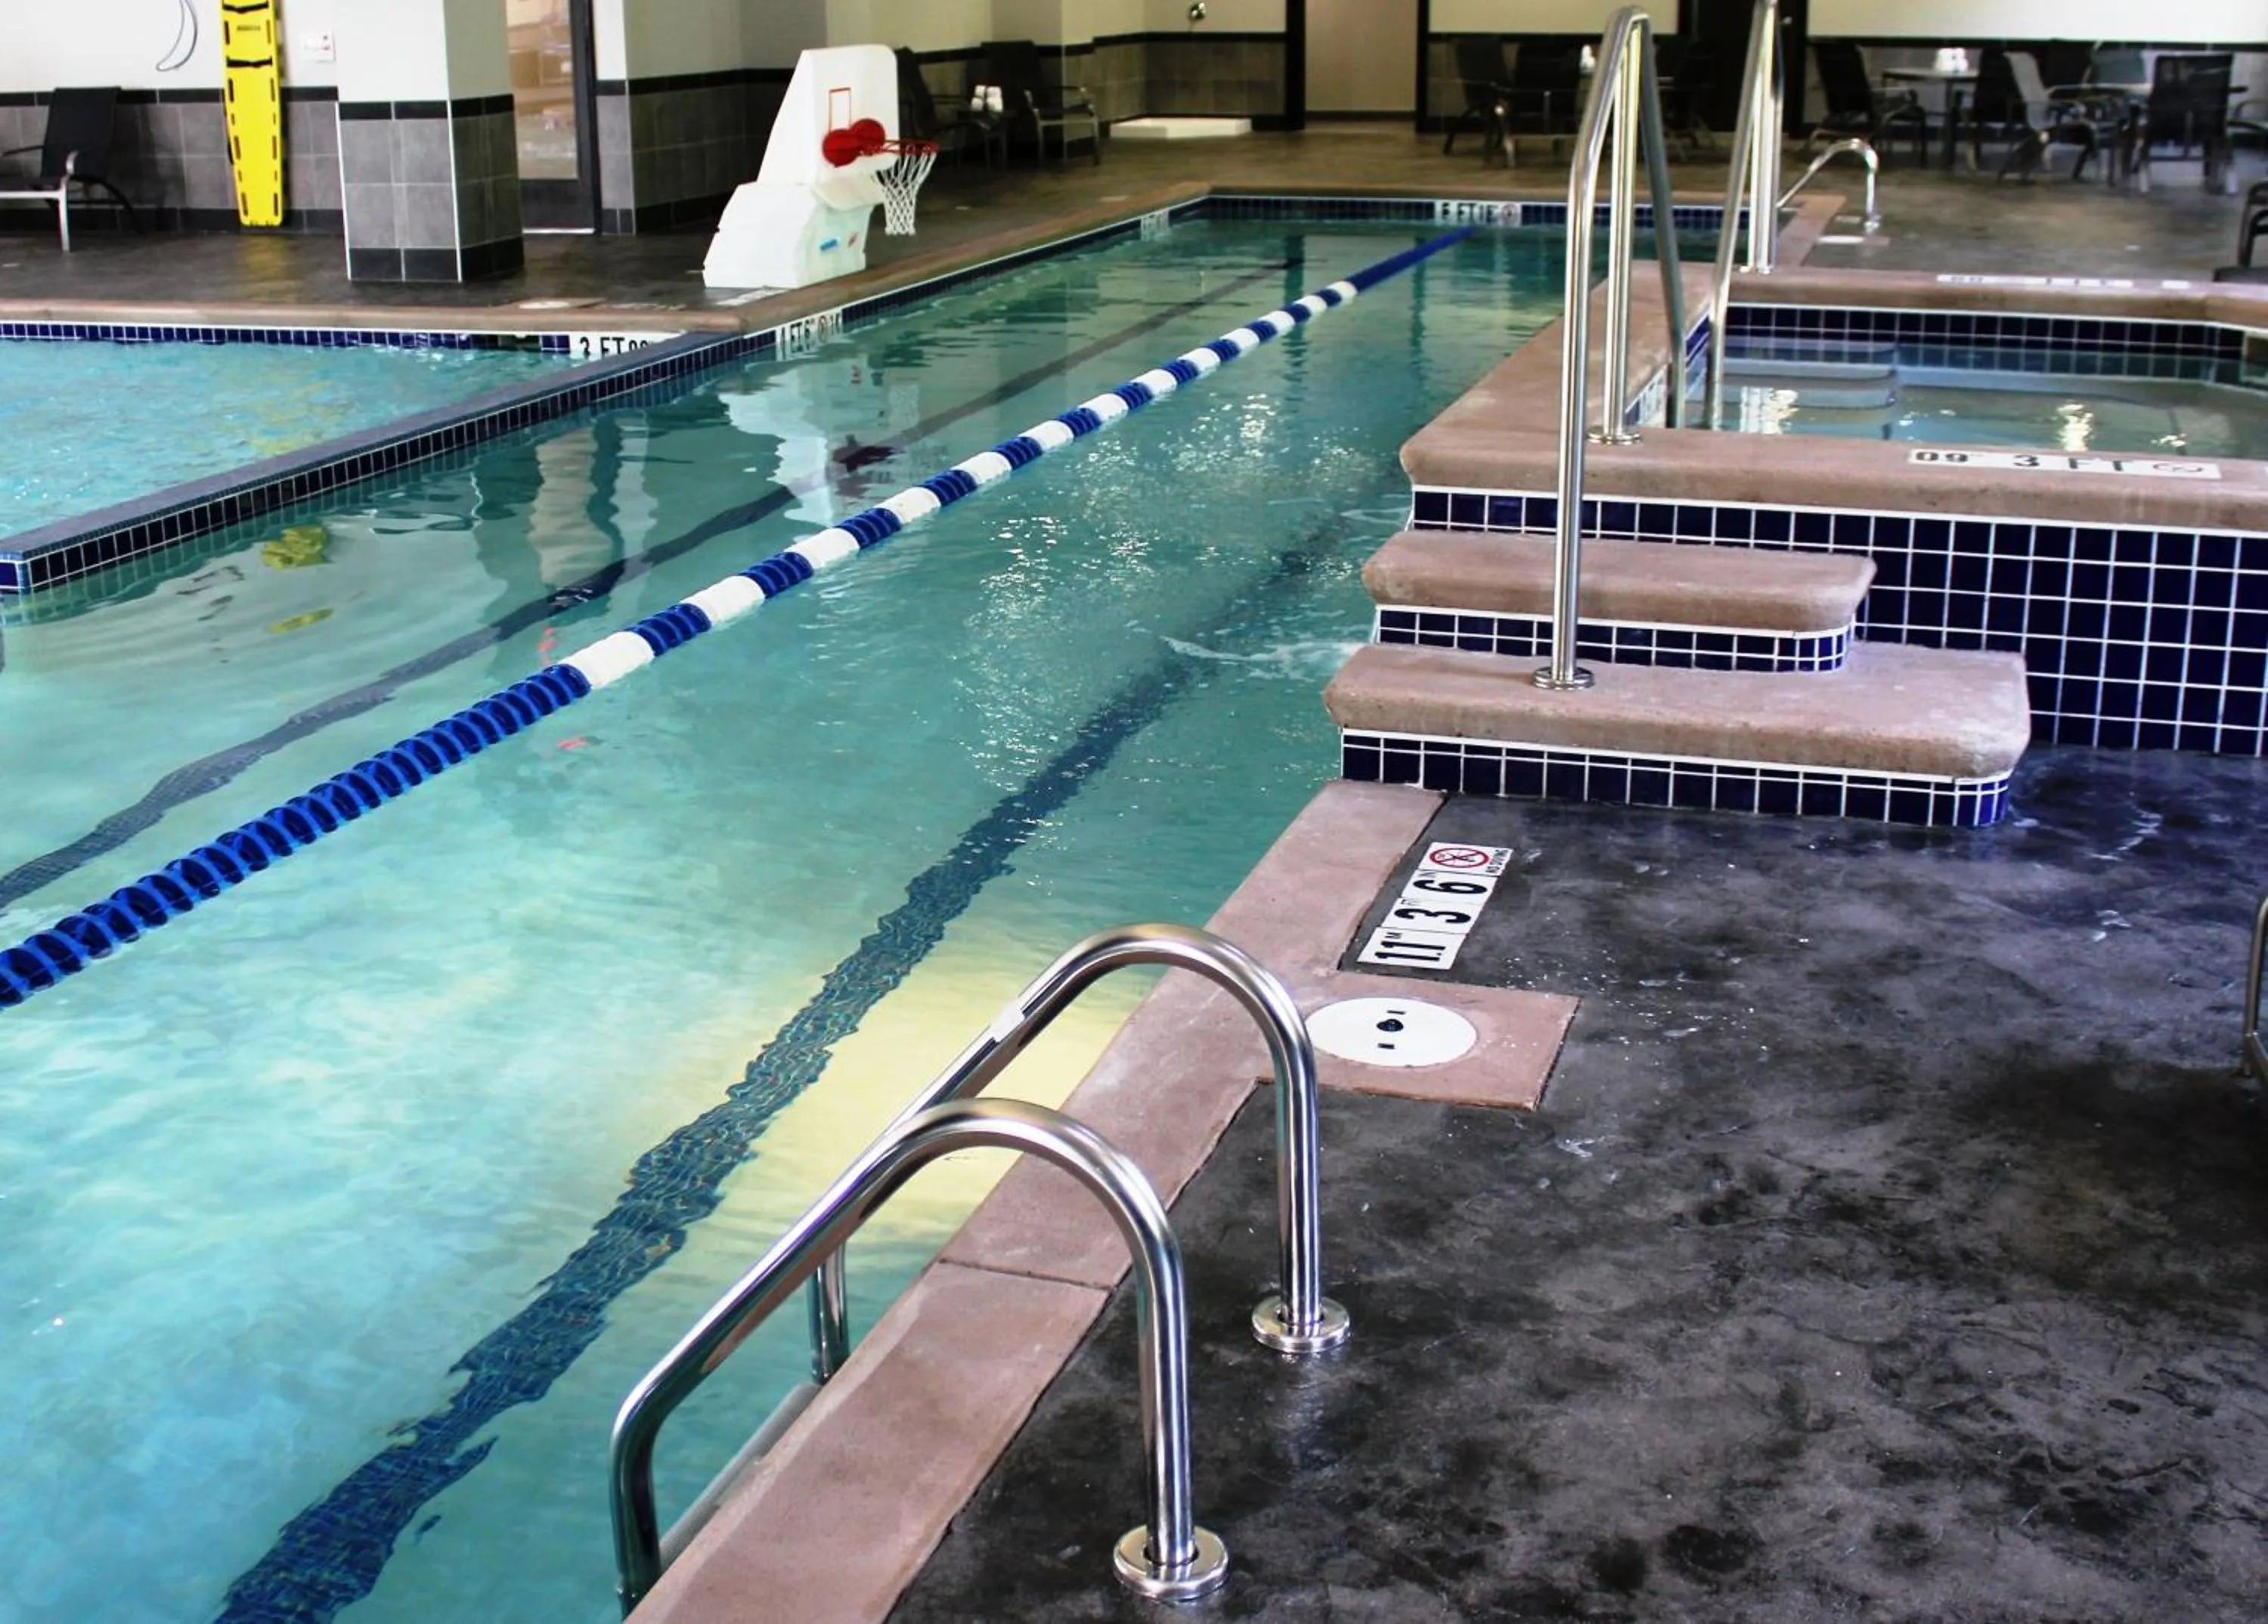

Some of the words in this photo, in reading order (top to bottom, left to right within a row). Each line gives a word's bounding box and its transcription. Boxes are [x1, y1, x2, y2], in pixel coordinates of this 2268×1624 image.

[600, 337, 625, 355] FT
[2014, 454, 2040, 467] 3
[1413, 879, 1488, 894] 6
[1394, 908, 1471, 924] 3
